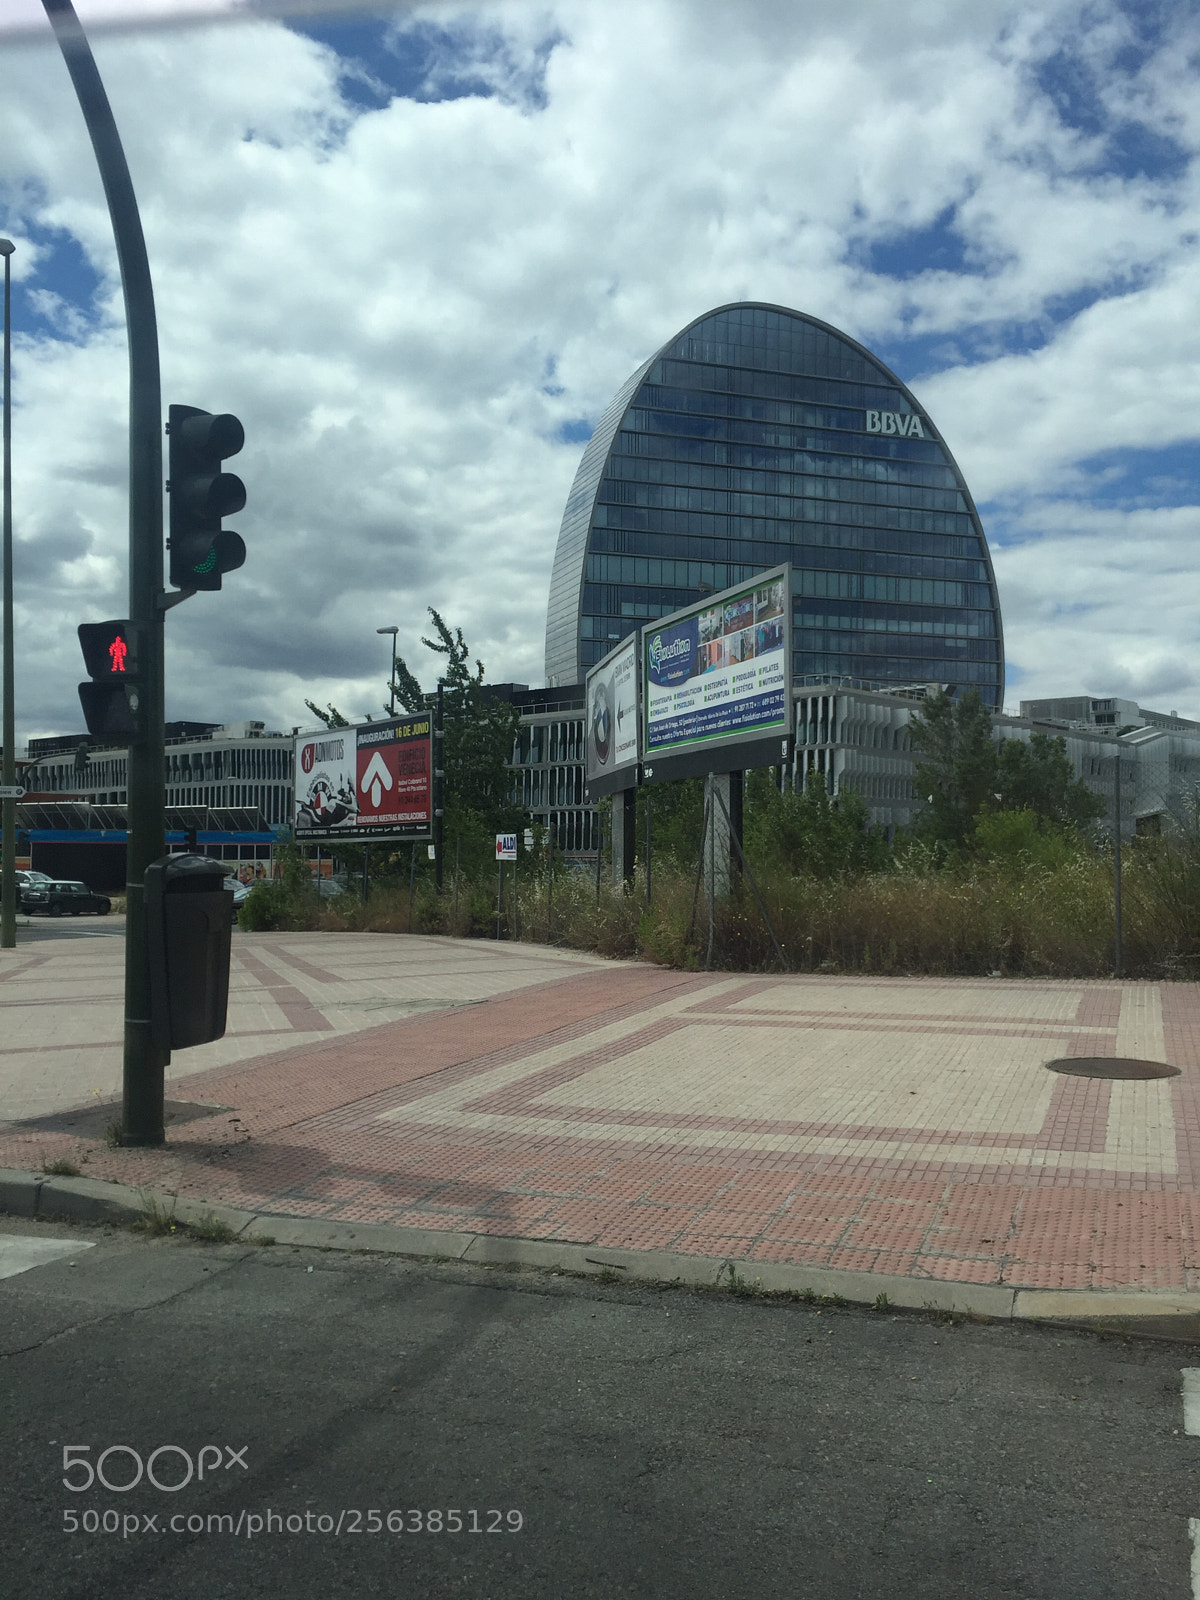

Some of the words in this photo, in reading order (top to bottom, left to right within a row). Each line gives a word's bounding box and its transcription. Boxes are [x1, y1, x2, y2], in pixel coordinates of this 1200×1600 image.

[866, 410, 925, 438] BBVA
[763, 662, 779, 674] PILATES
[395, 727, 403, 738] 16
[403, 725, 411, 737] DE
[411, 721, 429, 736] JUNIO
[503, 836, 517, 850] ALDI
